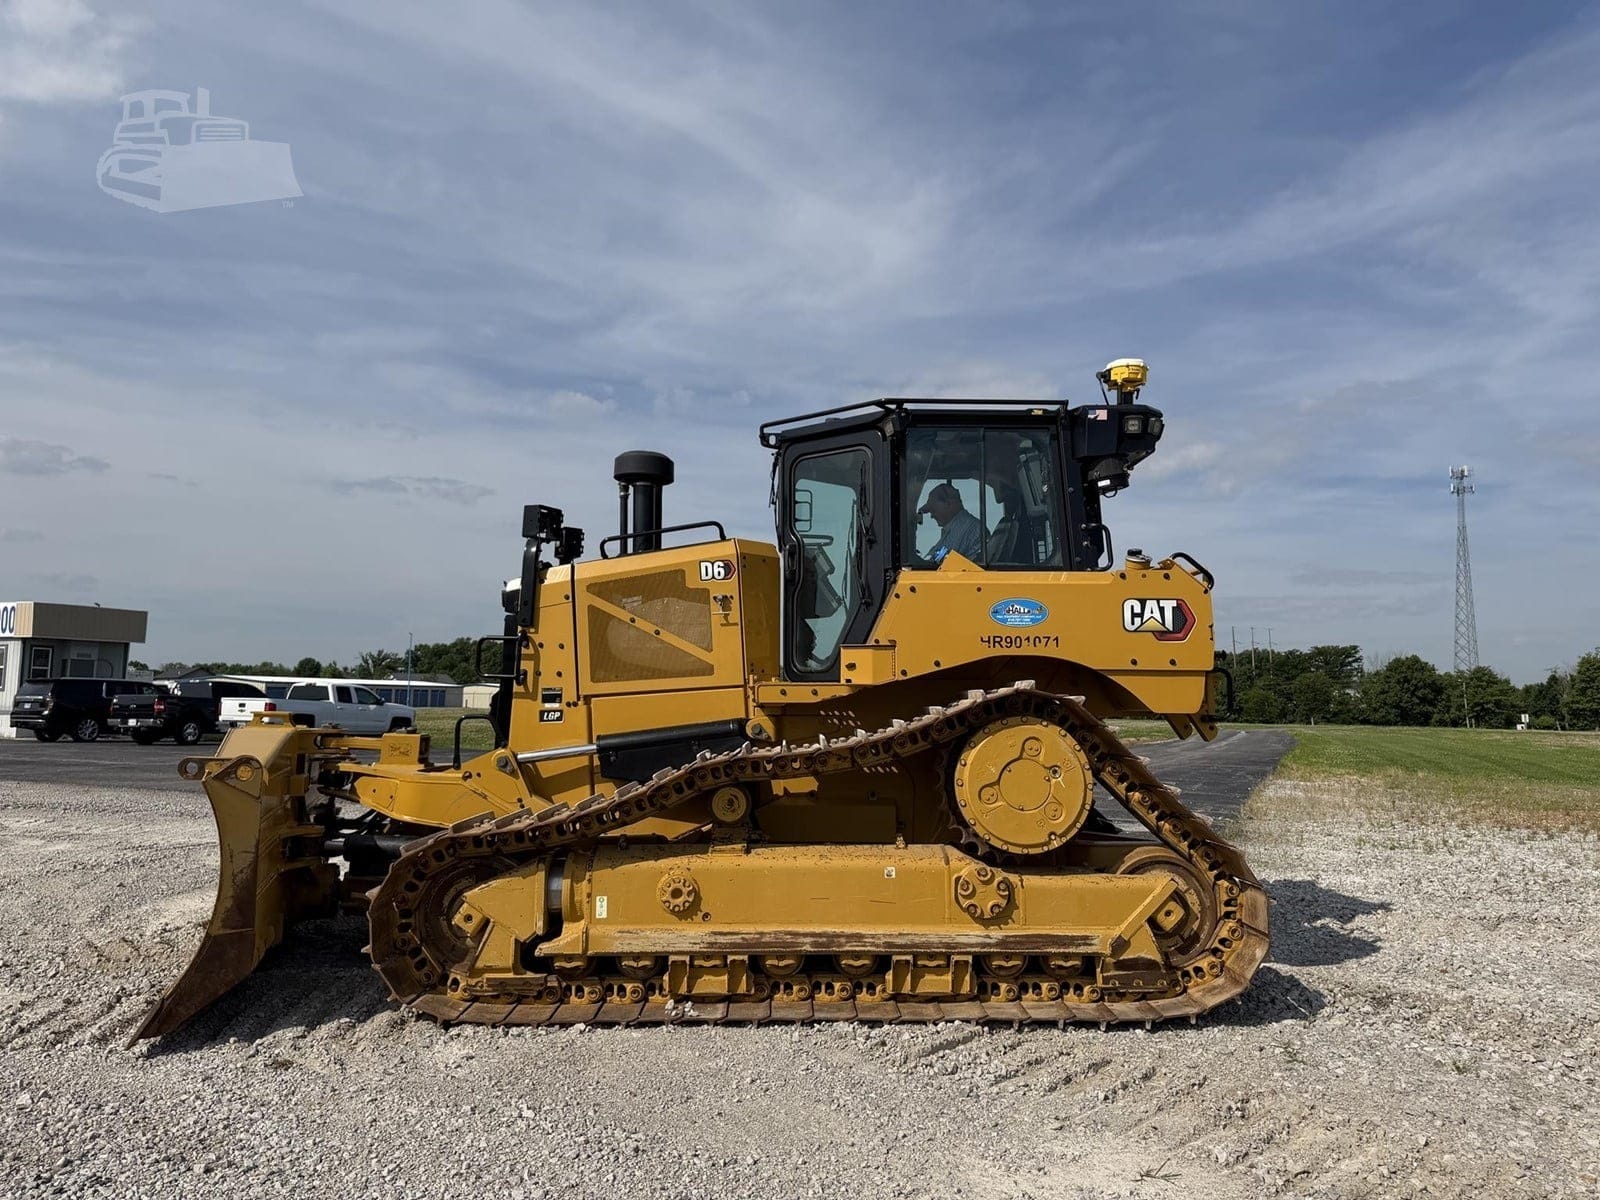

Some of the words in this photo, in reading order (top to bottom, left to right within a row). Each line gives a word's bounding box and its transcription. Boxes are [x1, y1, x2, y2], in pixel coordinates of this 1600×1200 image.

[699, 560, 725, 580] D6
[0, 606, 16, 634] 00
[1122, 599, 1177, 631] CAT
[543, 711, 561, 721] LGP
